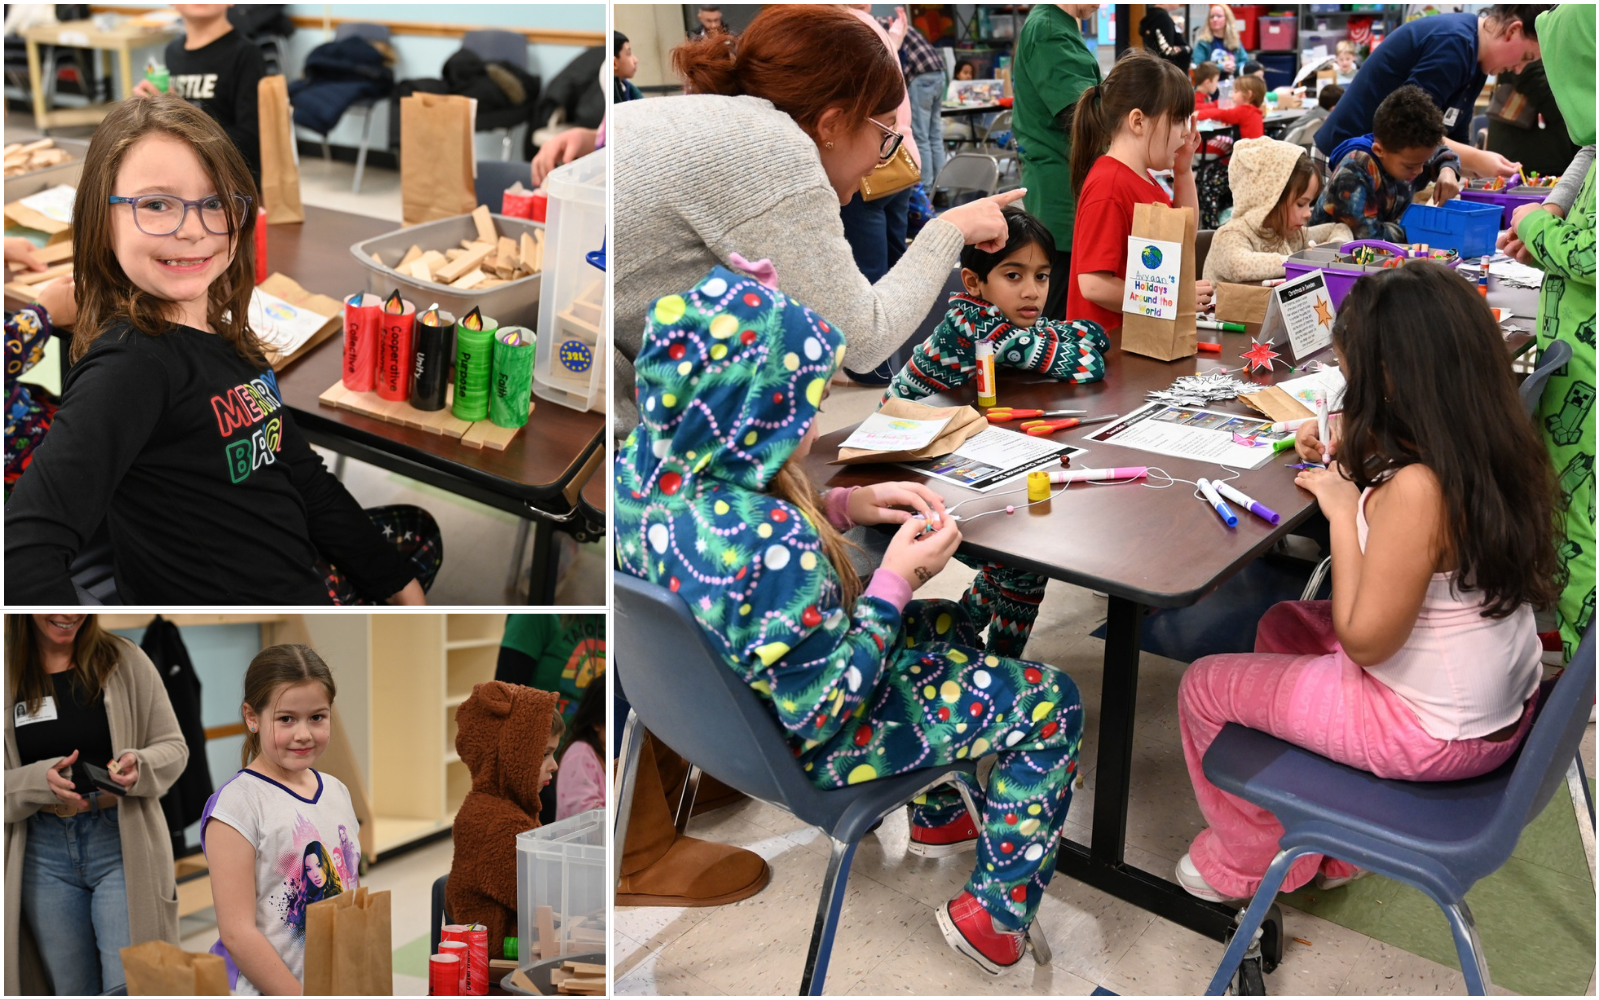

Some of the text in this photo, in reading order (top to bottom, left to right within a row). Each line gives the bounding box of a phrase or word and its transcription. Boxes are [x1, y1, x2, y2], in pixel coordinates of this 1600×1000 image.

[1129, 291, 1173, 307] Around the
[1134, 281, 1168, 295] Holidays
[1139, 304, 1162, 317] World
[348, 322, 358, 374] Collective
[389, 326, 402, 392] Cooperative
[566, 351, 586, 362] 32L
[413, 352, 425, 379] Unity
[459, 351, 471, 398] Purpose
[497, 372, 508, 398] Faith
[210, 369, 283, 437] MERRY
